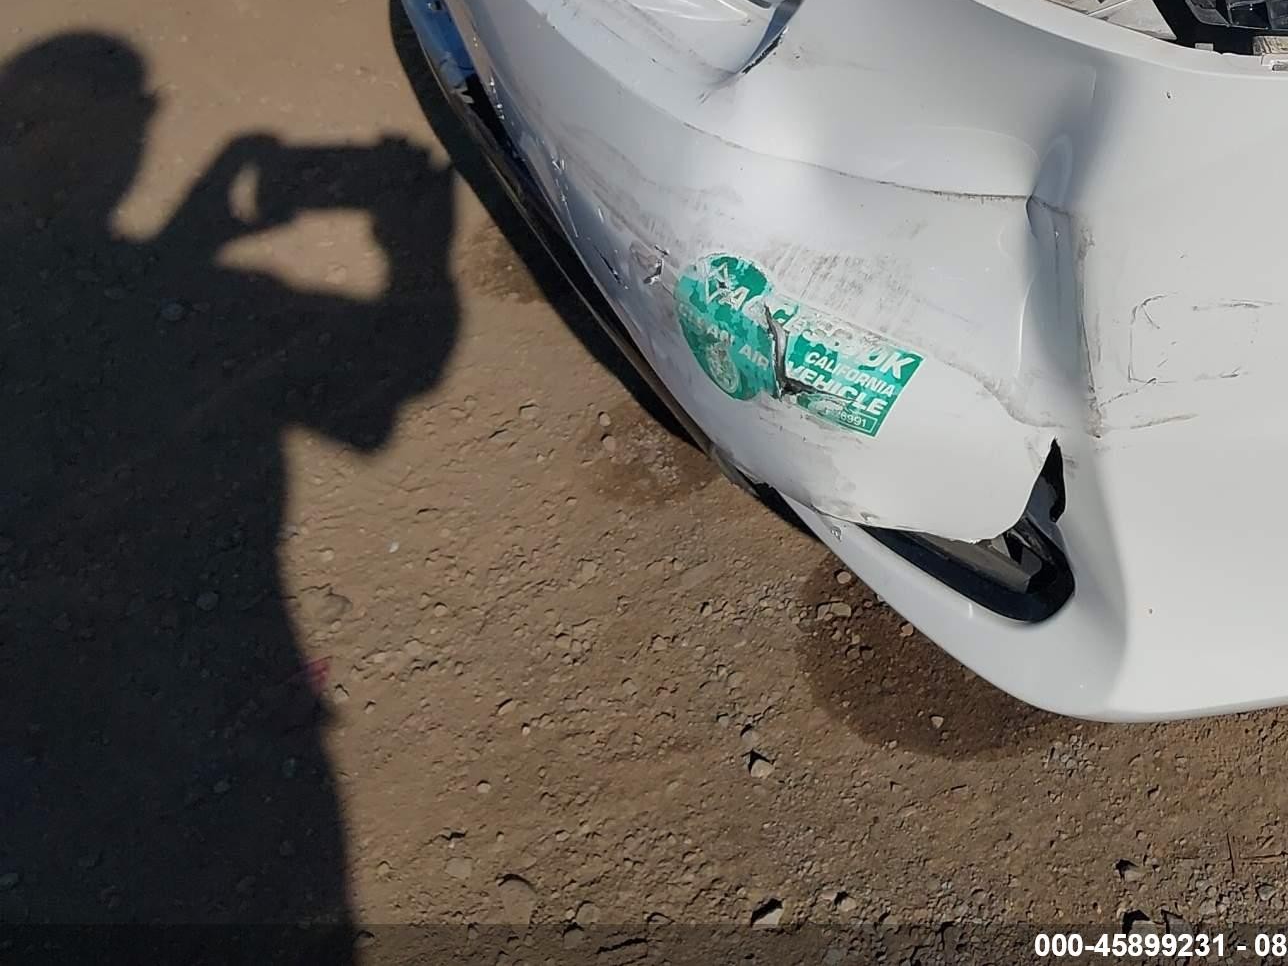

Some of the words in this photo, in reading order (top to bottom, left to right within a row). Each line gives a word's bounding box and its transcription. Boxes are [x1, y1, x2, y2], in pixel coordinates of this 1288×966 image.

[738, 343, 769, 371] AIR
[787, 361, 889, 416] VEHICLE
[804, 351, 897, 397] CALIFORNIA
